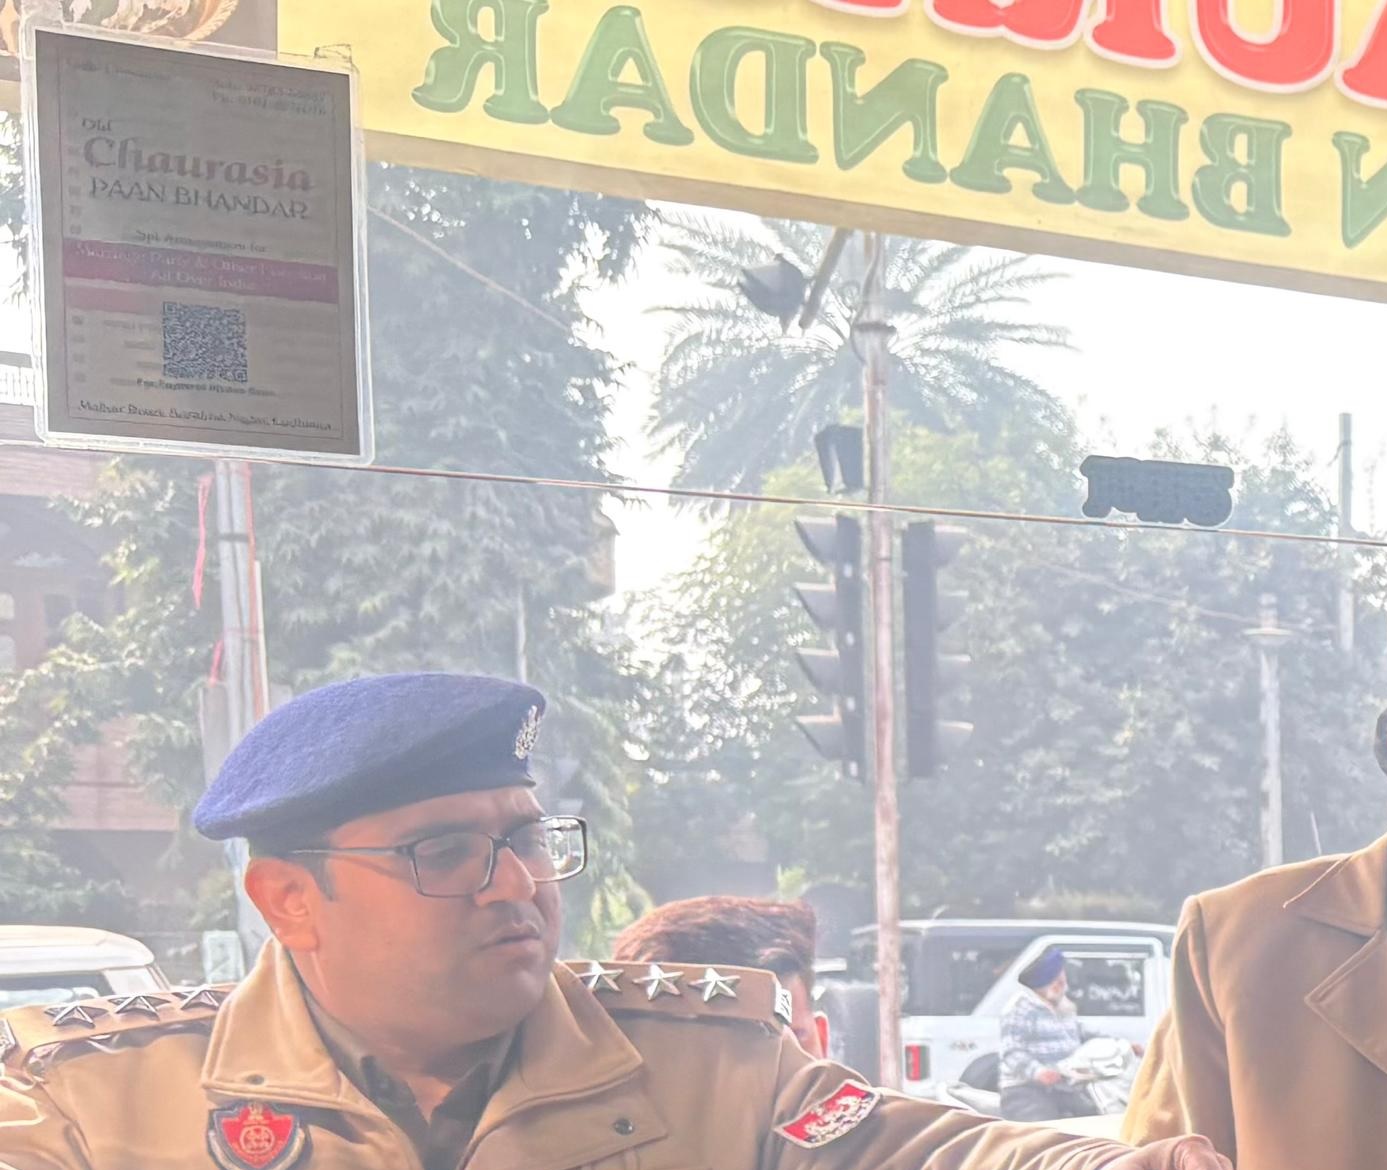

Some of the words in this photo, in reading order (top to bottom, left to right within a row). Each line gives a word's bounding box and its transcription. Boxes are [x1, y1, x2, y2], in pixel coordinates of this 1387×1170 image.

[82, 136, 313, 192] Chaurasia
[89, 175, 166, 203] PAAN
[174, 187, 309, 219] BHANDAR
